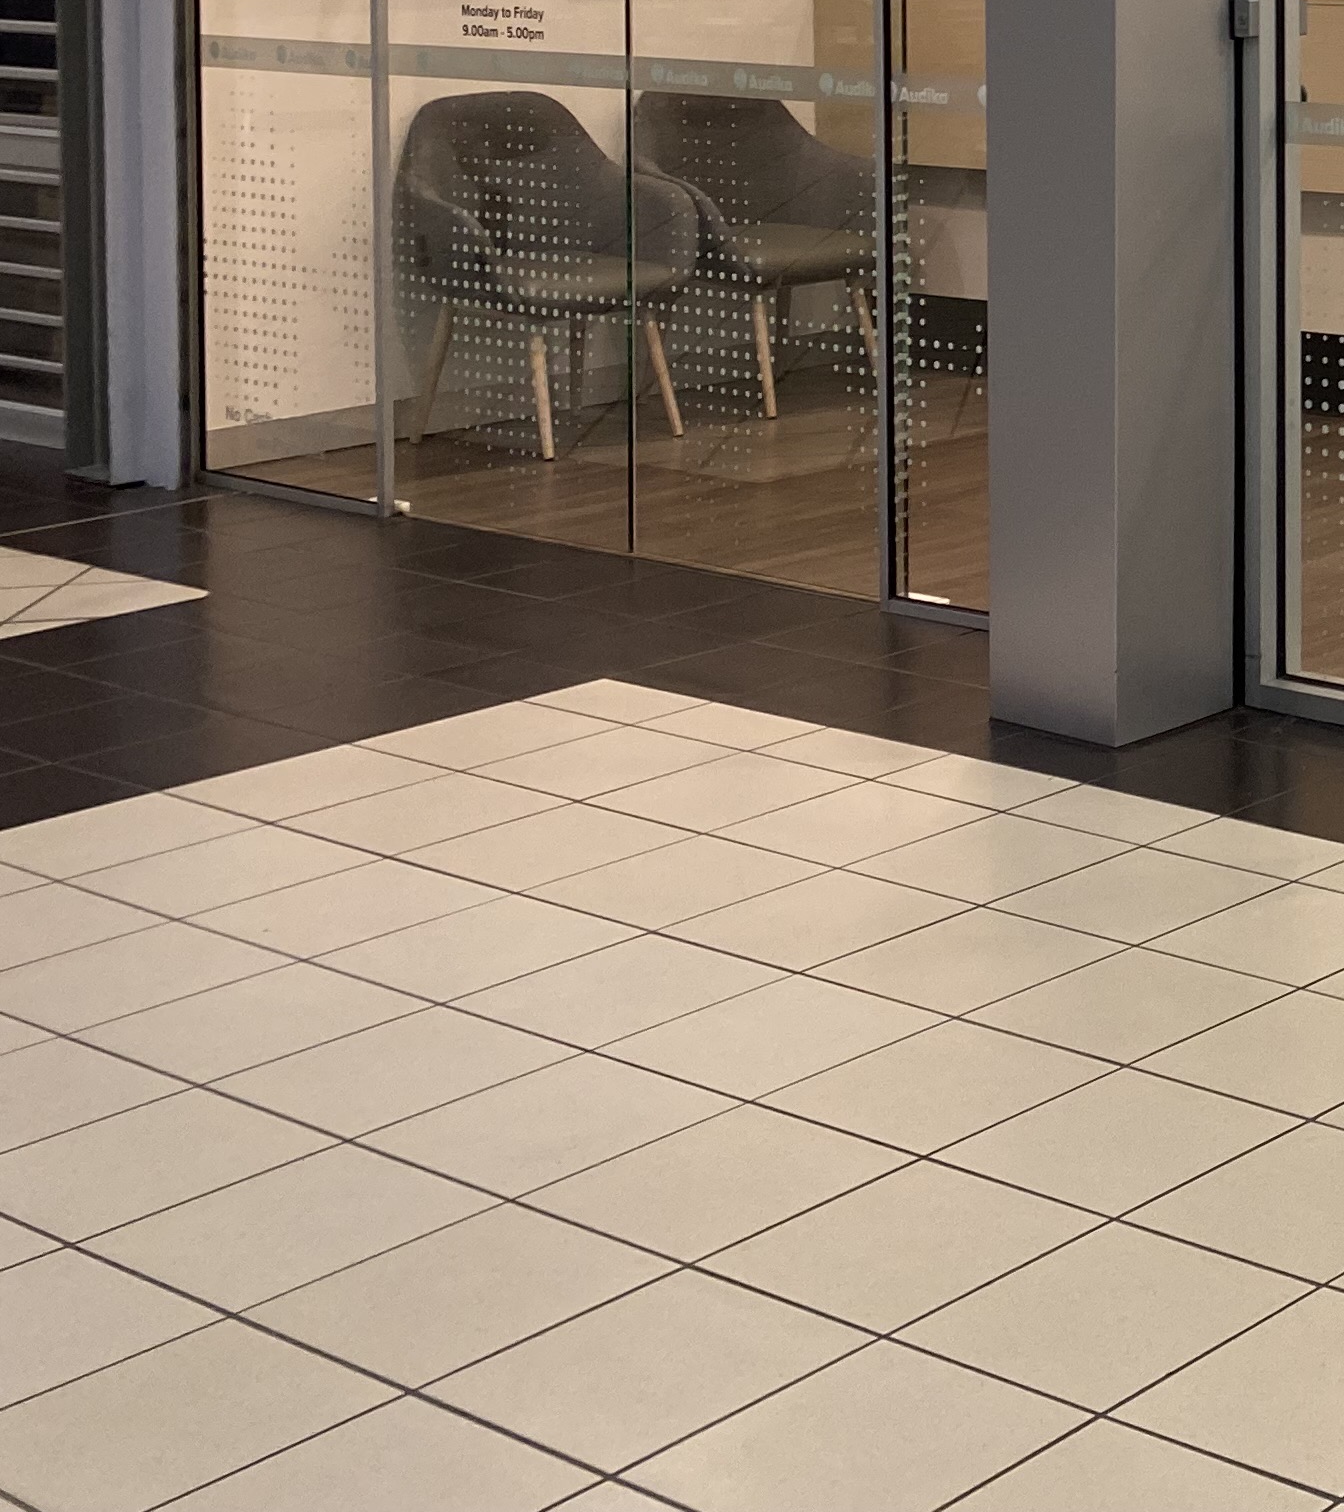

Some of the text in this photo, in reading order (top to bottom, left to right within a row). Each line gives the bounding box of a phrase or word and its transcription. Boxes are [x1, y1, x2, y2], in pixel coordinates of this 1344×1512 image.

[461, 5, 545, 22] Monday to Friday
[462, 25, 498, 38] 9.00am
[506, 26, 545, 42] 5.00pm
[899, 87, 949, 105] Audika
